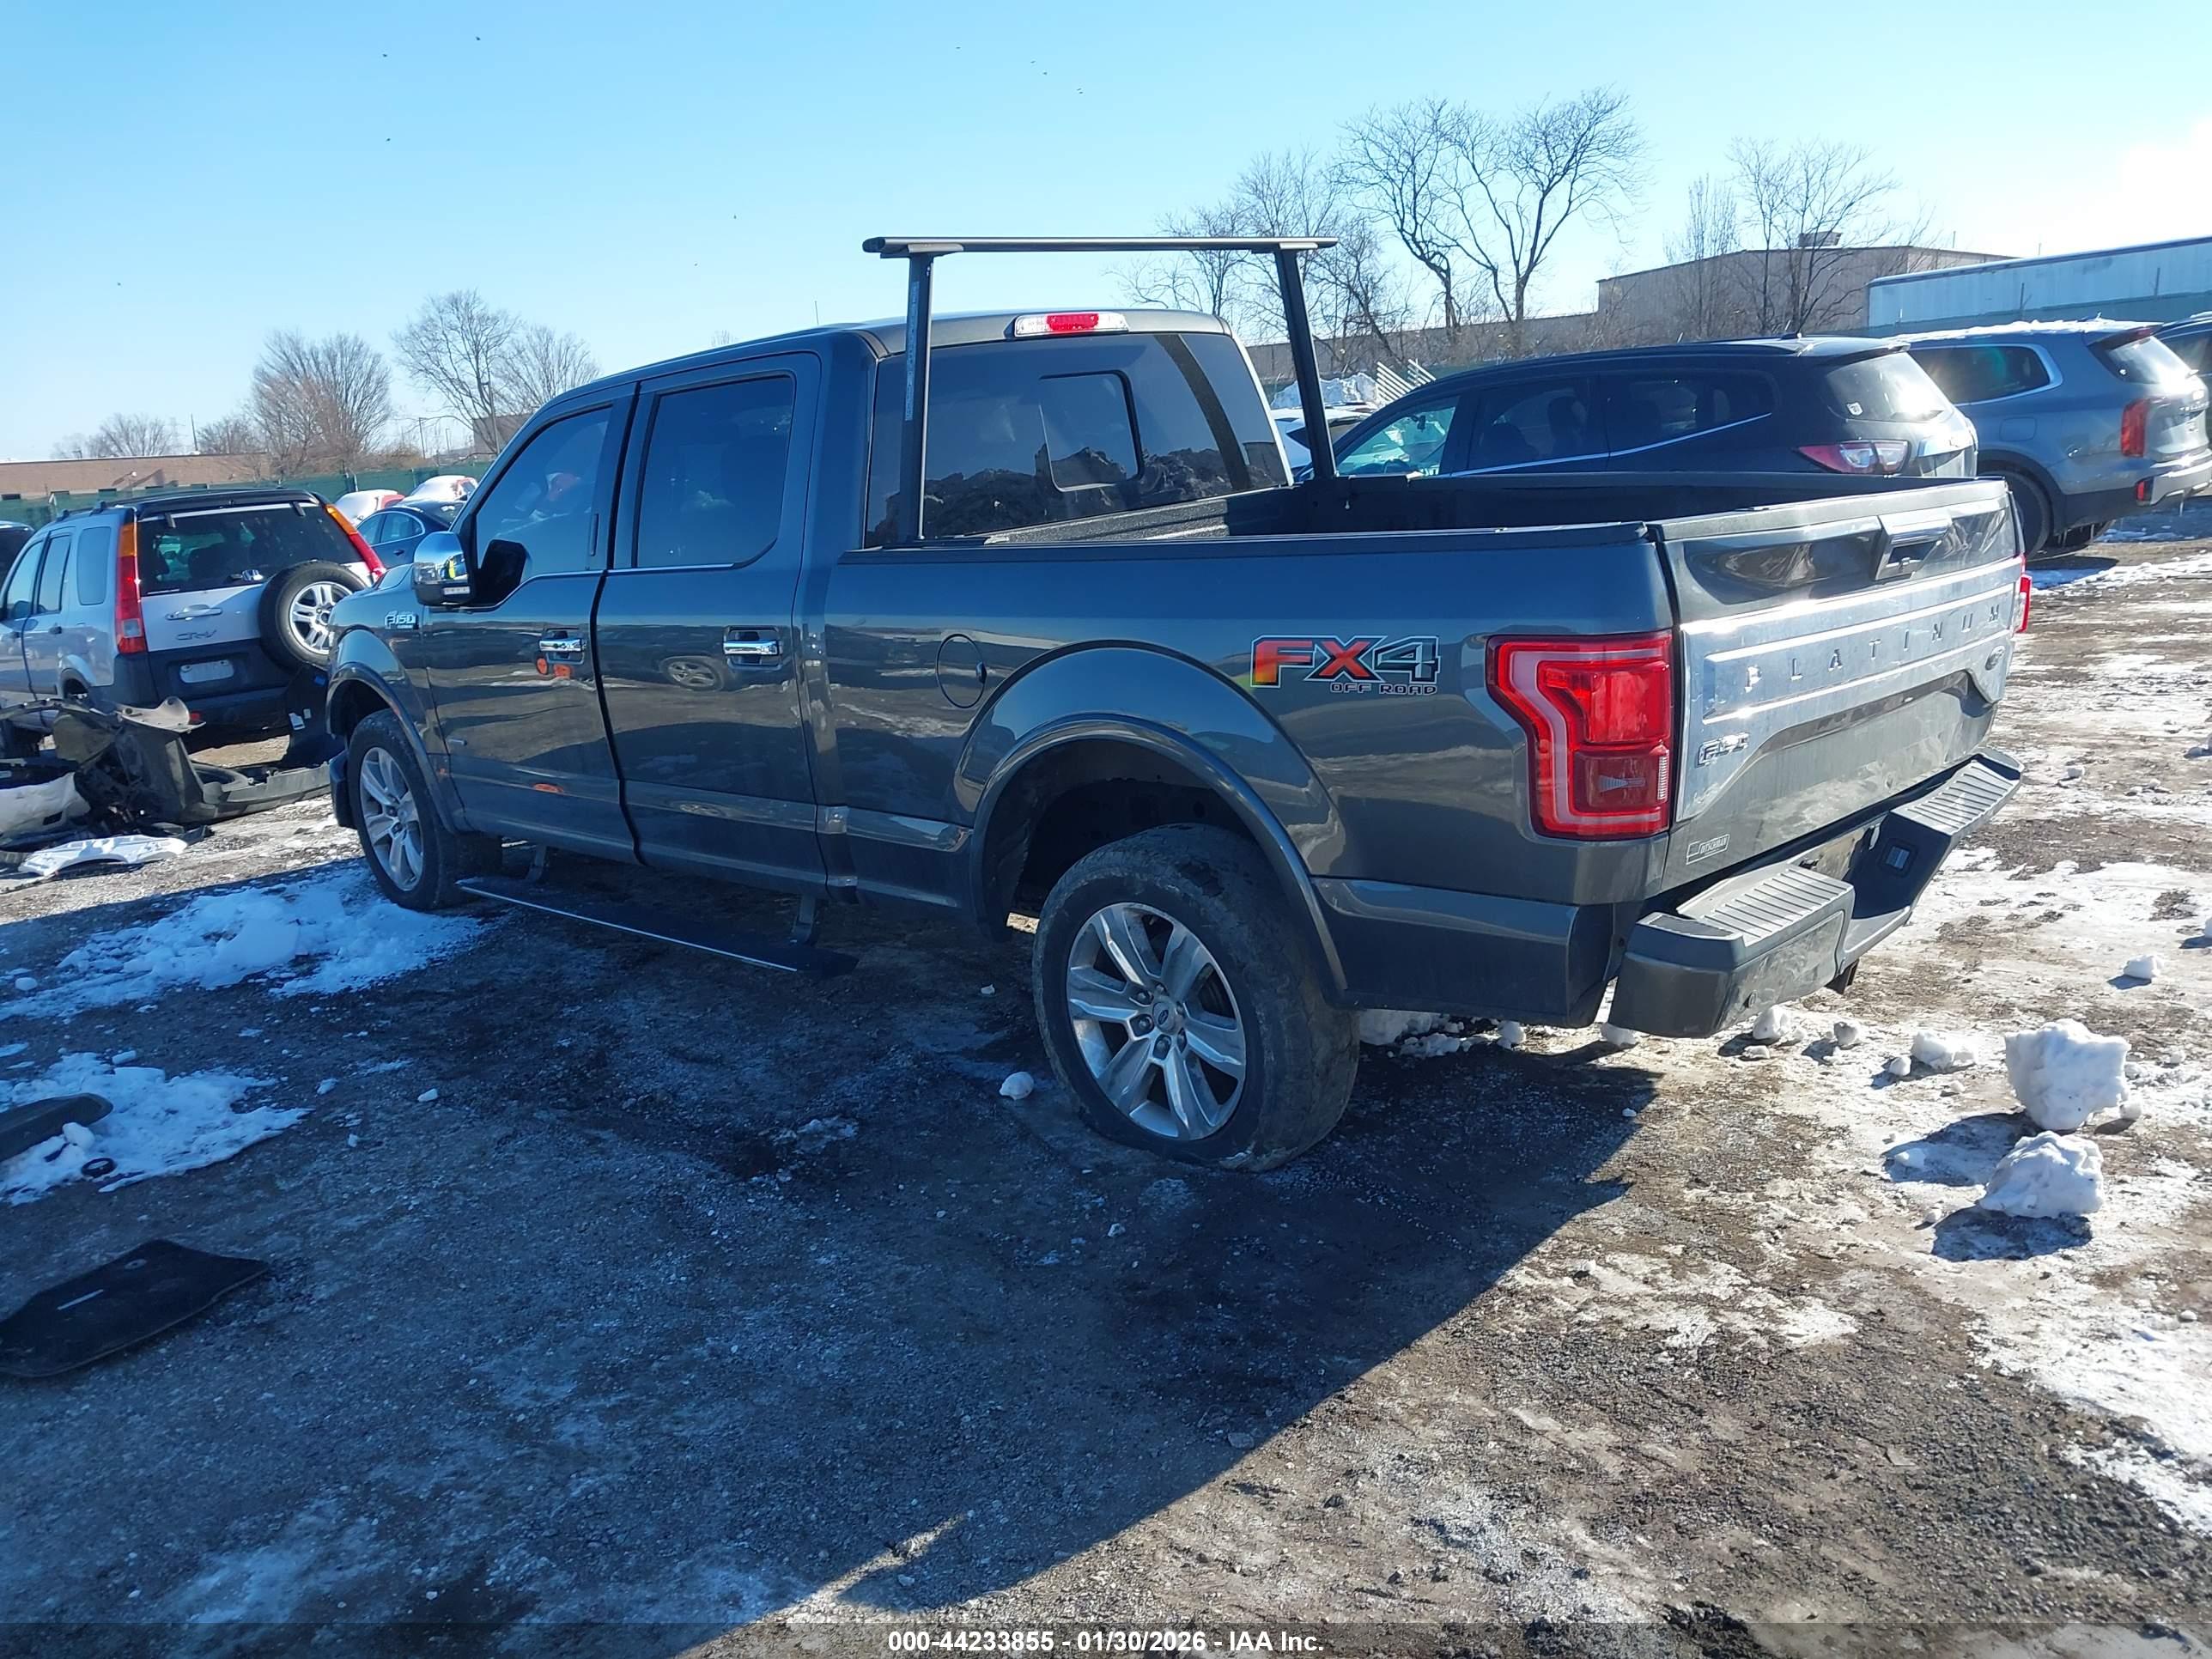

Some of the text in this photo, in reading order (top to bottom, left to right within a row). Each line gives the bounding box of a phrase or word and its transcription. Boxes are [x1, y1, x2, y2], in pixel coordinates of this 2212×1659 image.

[1250, 635, 1441, 688] FX4
[1745, 604, 2000, 692] PLATINUM
[1330, 683, 1437, 696] OFF ROAD
